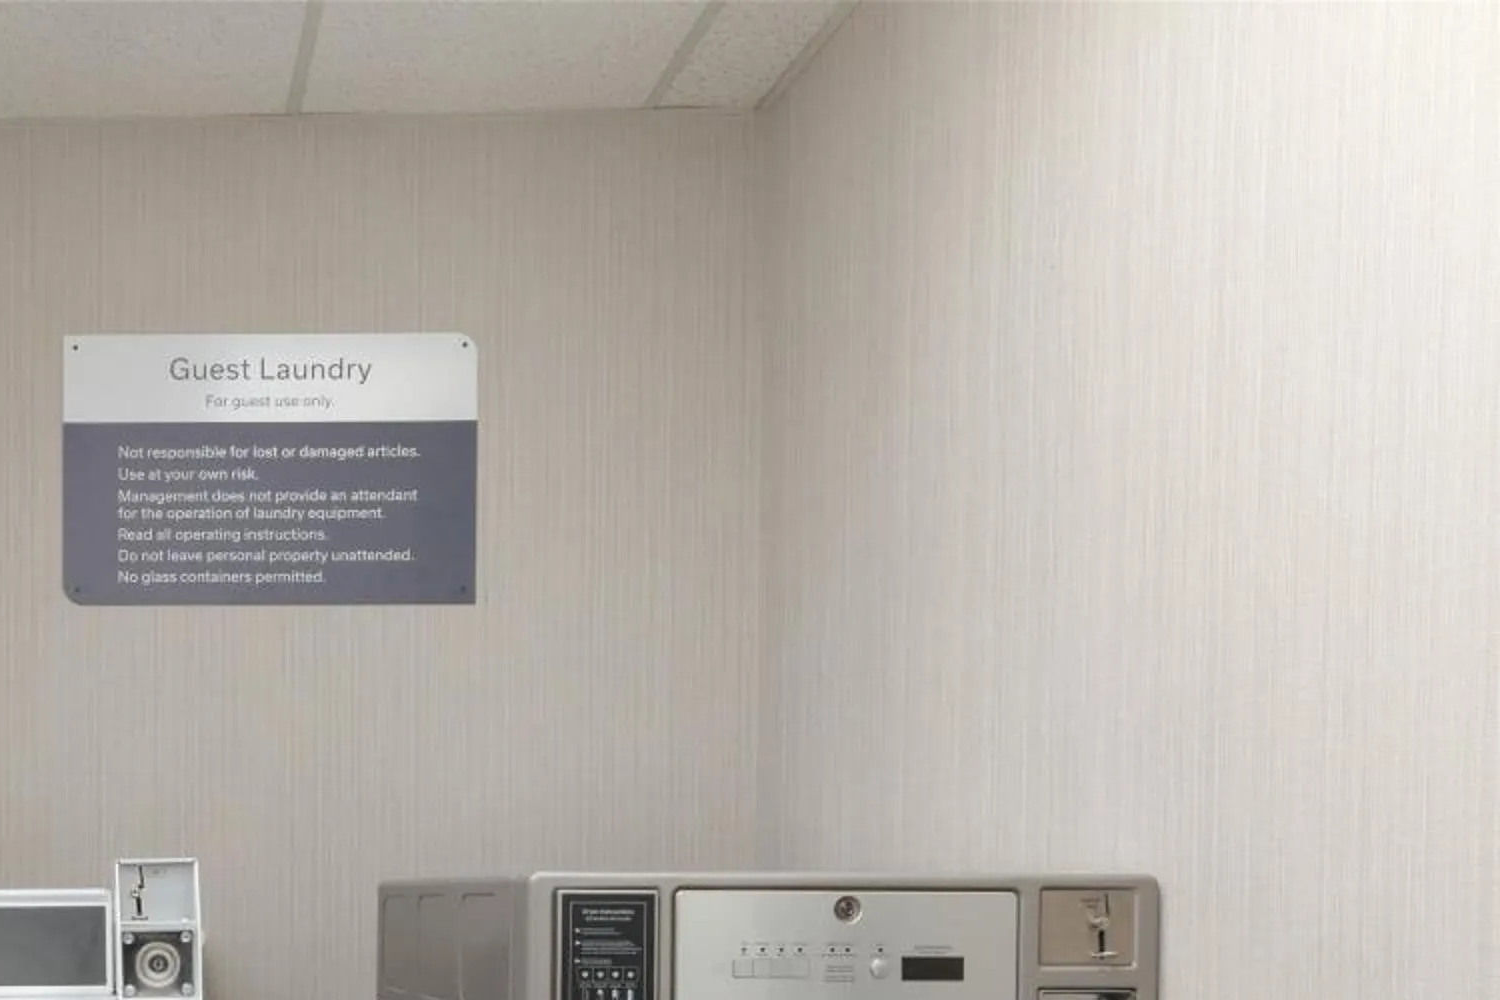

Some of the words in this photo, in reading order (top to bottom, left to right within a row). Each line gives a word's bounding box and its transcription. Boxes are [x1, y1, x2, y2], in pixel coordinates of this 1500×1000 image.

[169, 357, 250, 381] Guest
[260, 357, 372, 385] Laundry
[205, 394, 228, 408] For
[232, 396, 270, 411] guest
[275, 396, 299, 408] use
[303, 394, 335, 410] only.
[118, 445, 144, 459] Not
[147, 445, 226, 461] responsible
[229, 445, 249, 459] for
[253, 444, 278, 459] lost
[281, 447, 296, 459] or
[299, 445, 365, 461] damaged
[367, 444, 421, 458] articles.
[118, 467, 145, 481] Use
[148, 468, 161, 481] at
[164, 470, 194, 483] your
[197, 470, 228, 481] own
[231, 466, 259, 481] risk.
[118, 489, 209, 505] Management
[212, 489, 245, 502] does
[249, 490, 271, 502] not
[275, 489, 328, 505] provide
[330, 491, 347, 502] an
[350, 489, 418, 502] attendant
[118, 506, 138, 520] for
[141, 507, 163, 520] the
[166, 506, 232, 522] operation
[235, 505, 251, 520] of
[253, 506, 305, 521] laundry
[308, 507, 387, 522] equipment.
[118, 527, 153, 541] Read
[175, 527, 241, 543] operating
[118, 549, 138, 562] Do
[141, 549, 164, 562] not
[167, 548, 203, 562] leave
[206, 548, 266, 563] personal
[269, 549, 329, 565] property
[332, 548, 415, 562] unattended.
[118, 570, 138, 584] No
[141, 570, 178, 586] glass
[180, 570, 252, 584] containers
